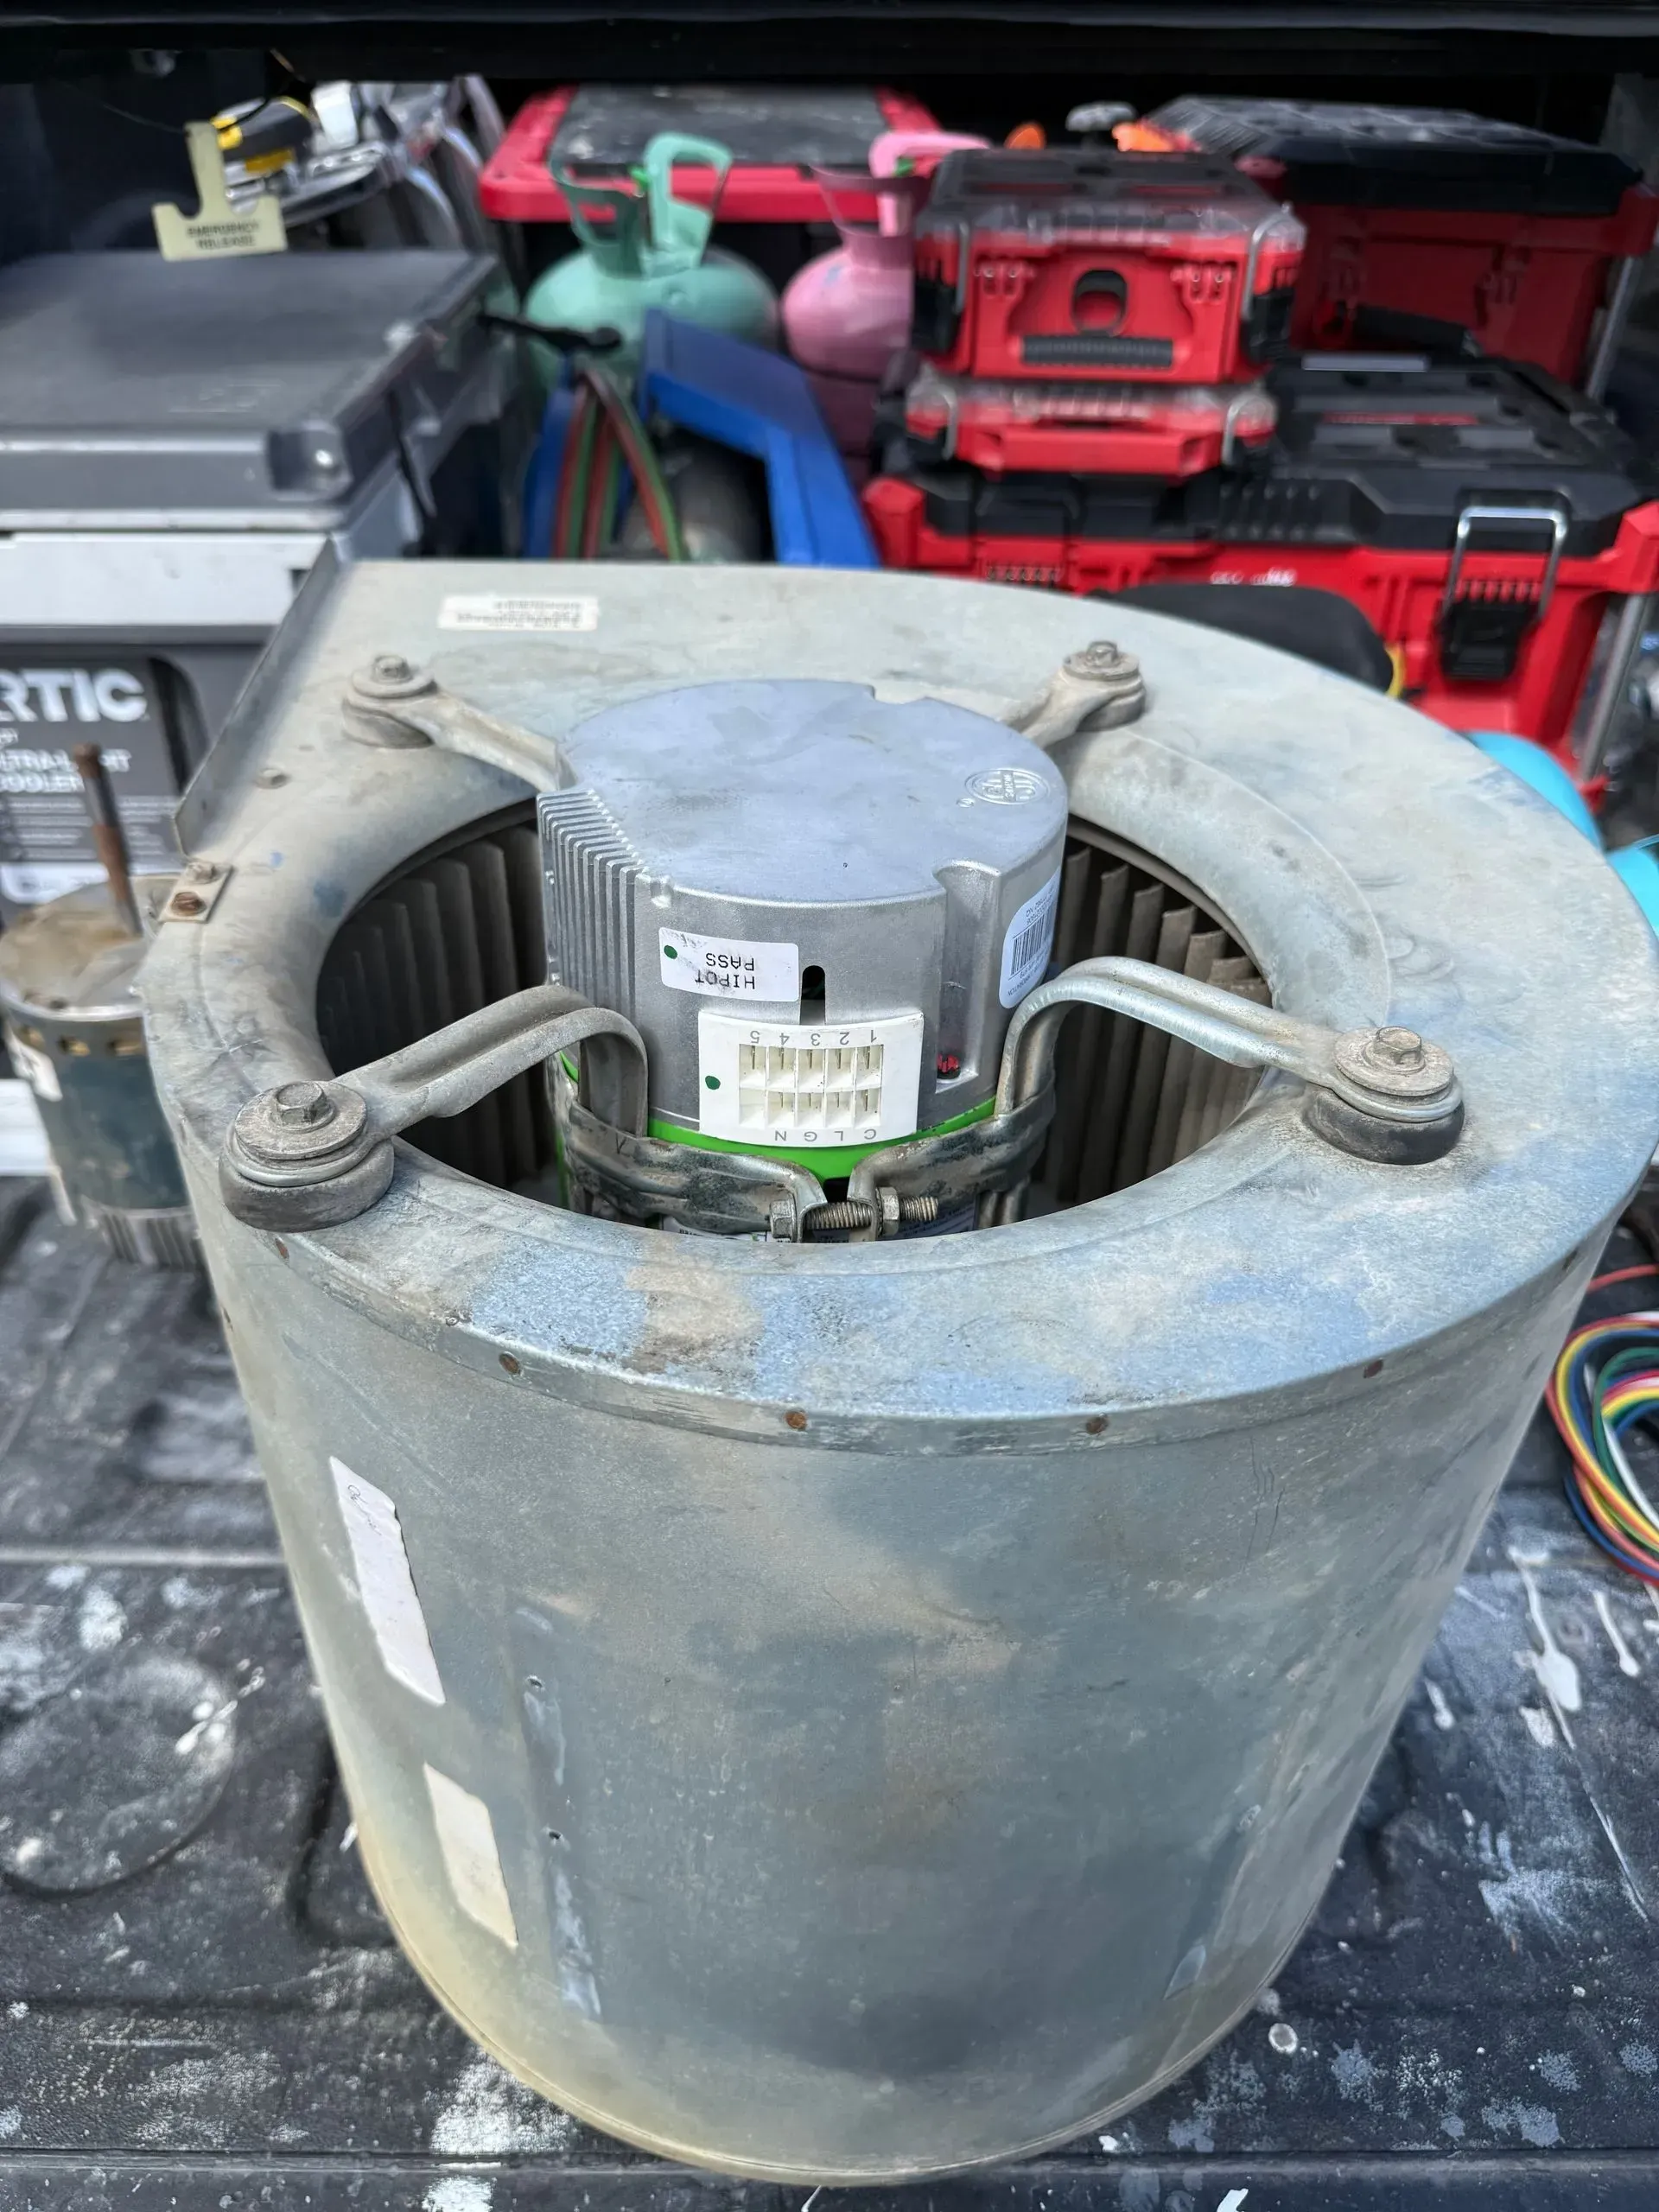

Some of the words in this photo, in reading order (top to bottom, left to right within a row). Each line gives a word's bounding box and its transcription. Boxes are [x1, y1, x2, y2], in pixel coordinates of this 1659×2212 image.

[705, 952, 755, 971] PASS
[695, 969, 756, 990] HIPOT
[750, 1030, 760, 1044] 5
[779, 1033, 790, 1046] 4
[810, 1033, 821, 1046] 3
[839, 1032, 850, 1046] 2
[870, 1029, 877, 1043] 1
[775, 1130, 787, 1141] N
[804, 1131, 817, 1142] G
[834, 1130, 844, 1141] L
[864, 1128, 877, 1140] C
